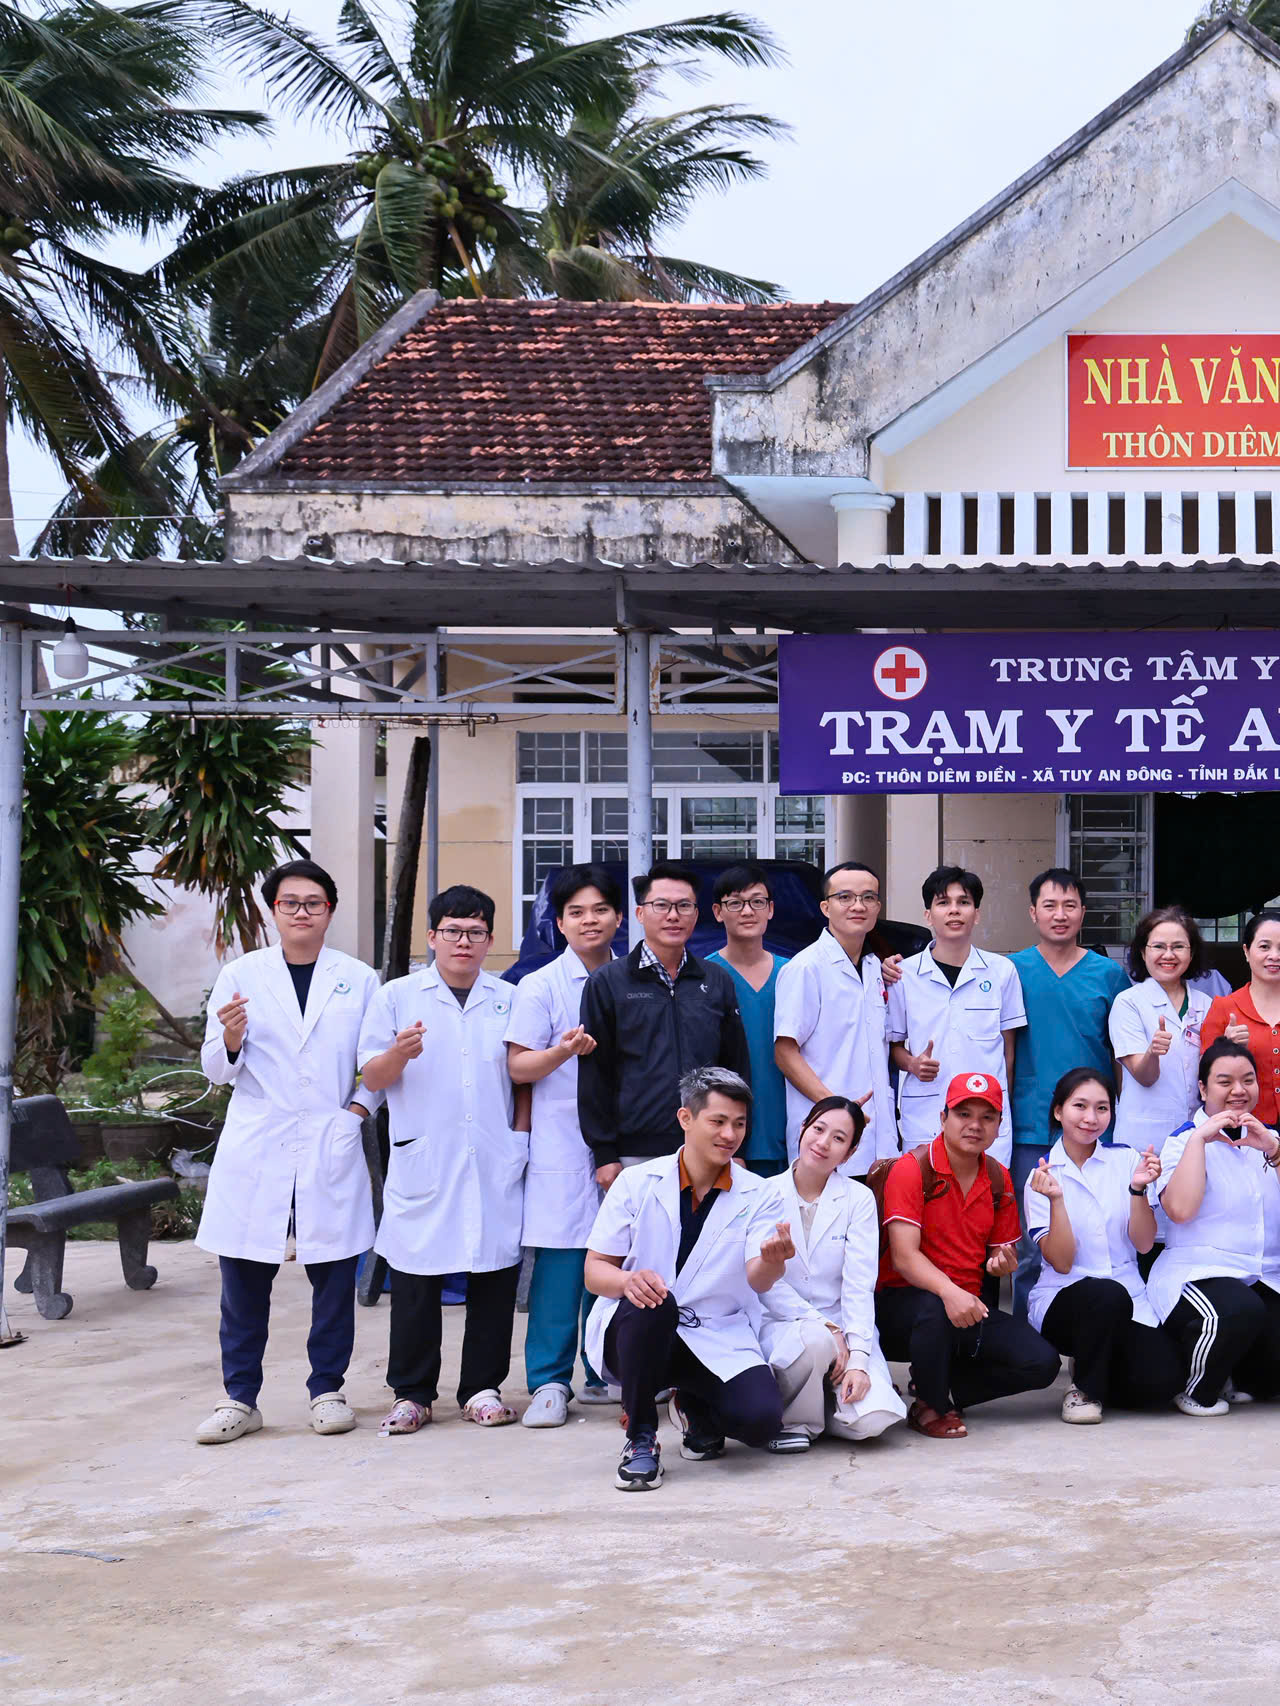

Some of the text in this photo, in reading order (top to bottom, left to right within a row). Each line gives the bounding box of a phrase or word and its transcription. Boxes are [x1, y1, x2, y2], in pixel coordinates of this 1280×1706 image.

[1083, 343, 1183, 405] NHÀ
[1102, 424, 1194, 458] THÔN
[990, 656, 1133, 682] TRUNG
[1147, 649, 1238, 681] TÂM
[1251, 656, 1280, 680] Y
[819, 709, 1023, 766] TRẠM
[1046, 709, 1094, 753] Y
[1114, 685, 1208, 753] TẾ
[841, 771, 871, 784] ĐC:
[875, 768, 922, 783] THÔN
[927, 768, 970, 783] DIÊM
[975, 765, 1016, 783] ĐIỀN
[1032, 767, 1055, 782] XÃ
[1059, 768, 1093, 782] TUY
[1097, 769, 1121, 782] AN
[1125, 766, 1173, 781] ĐÔNG
[1188, 764, 1228, 781] TỈNH
[1233, 763, 1269, 781] ĐẮK
